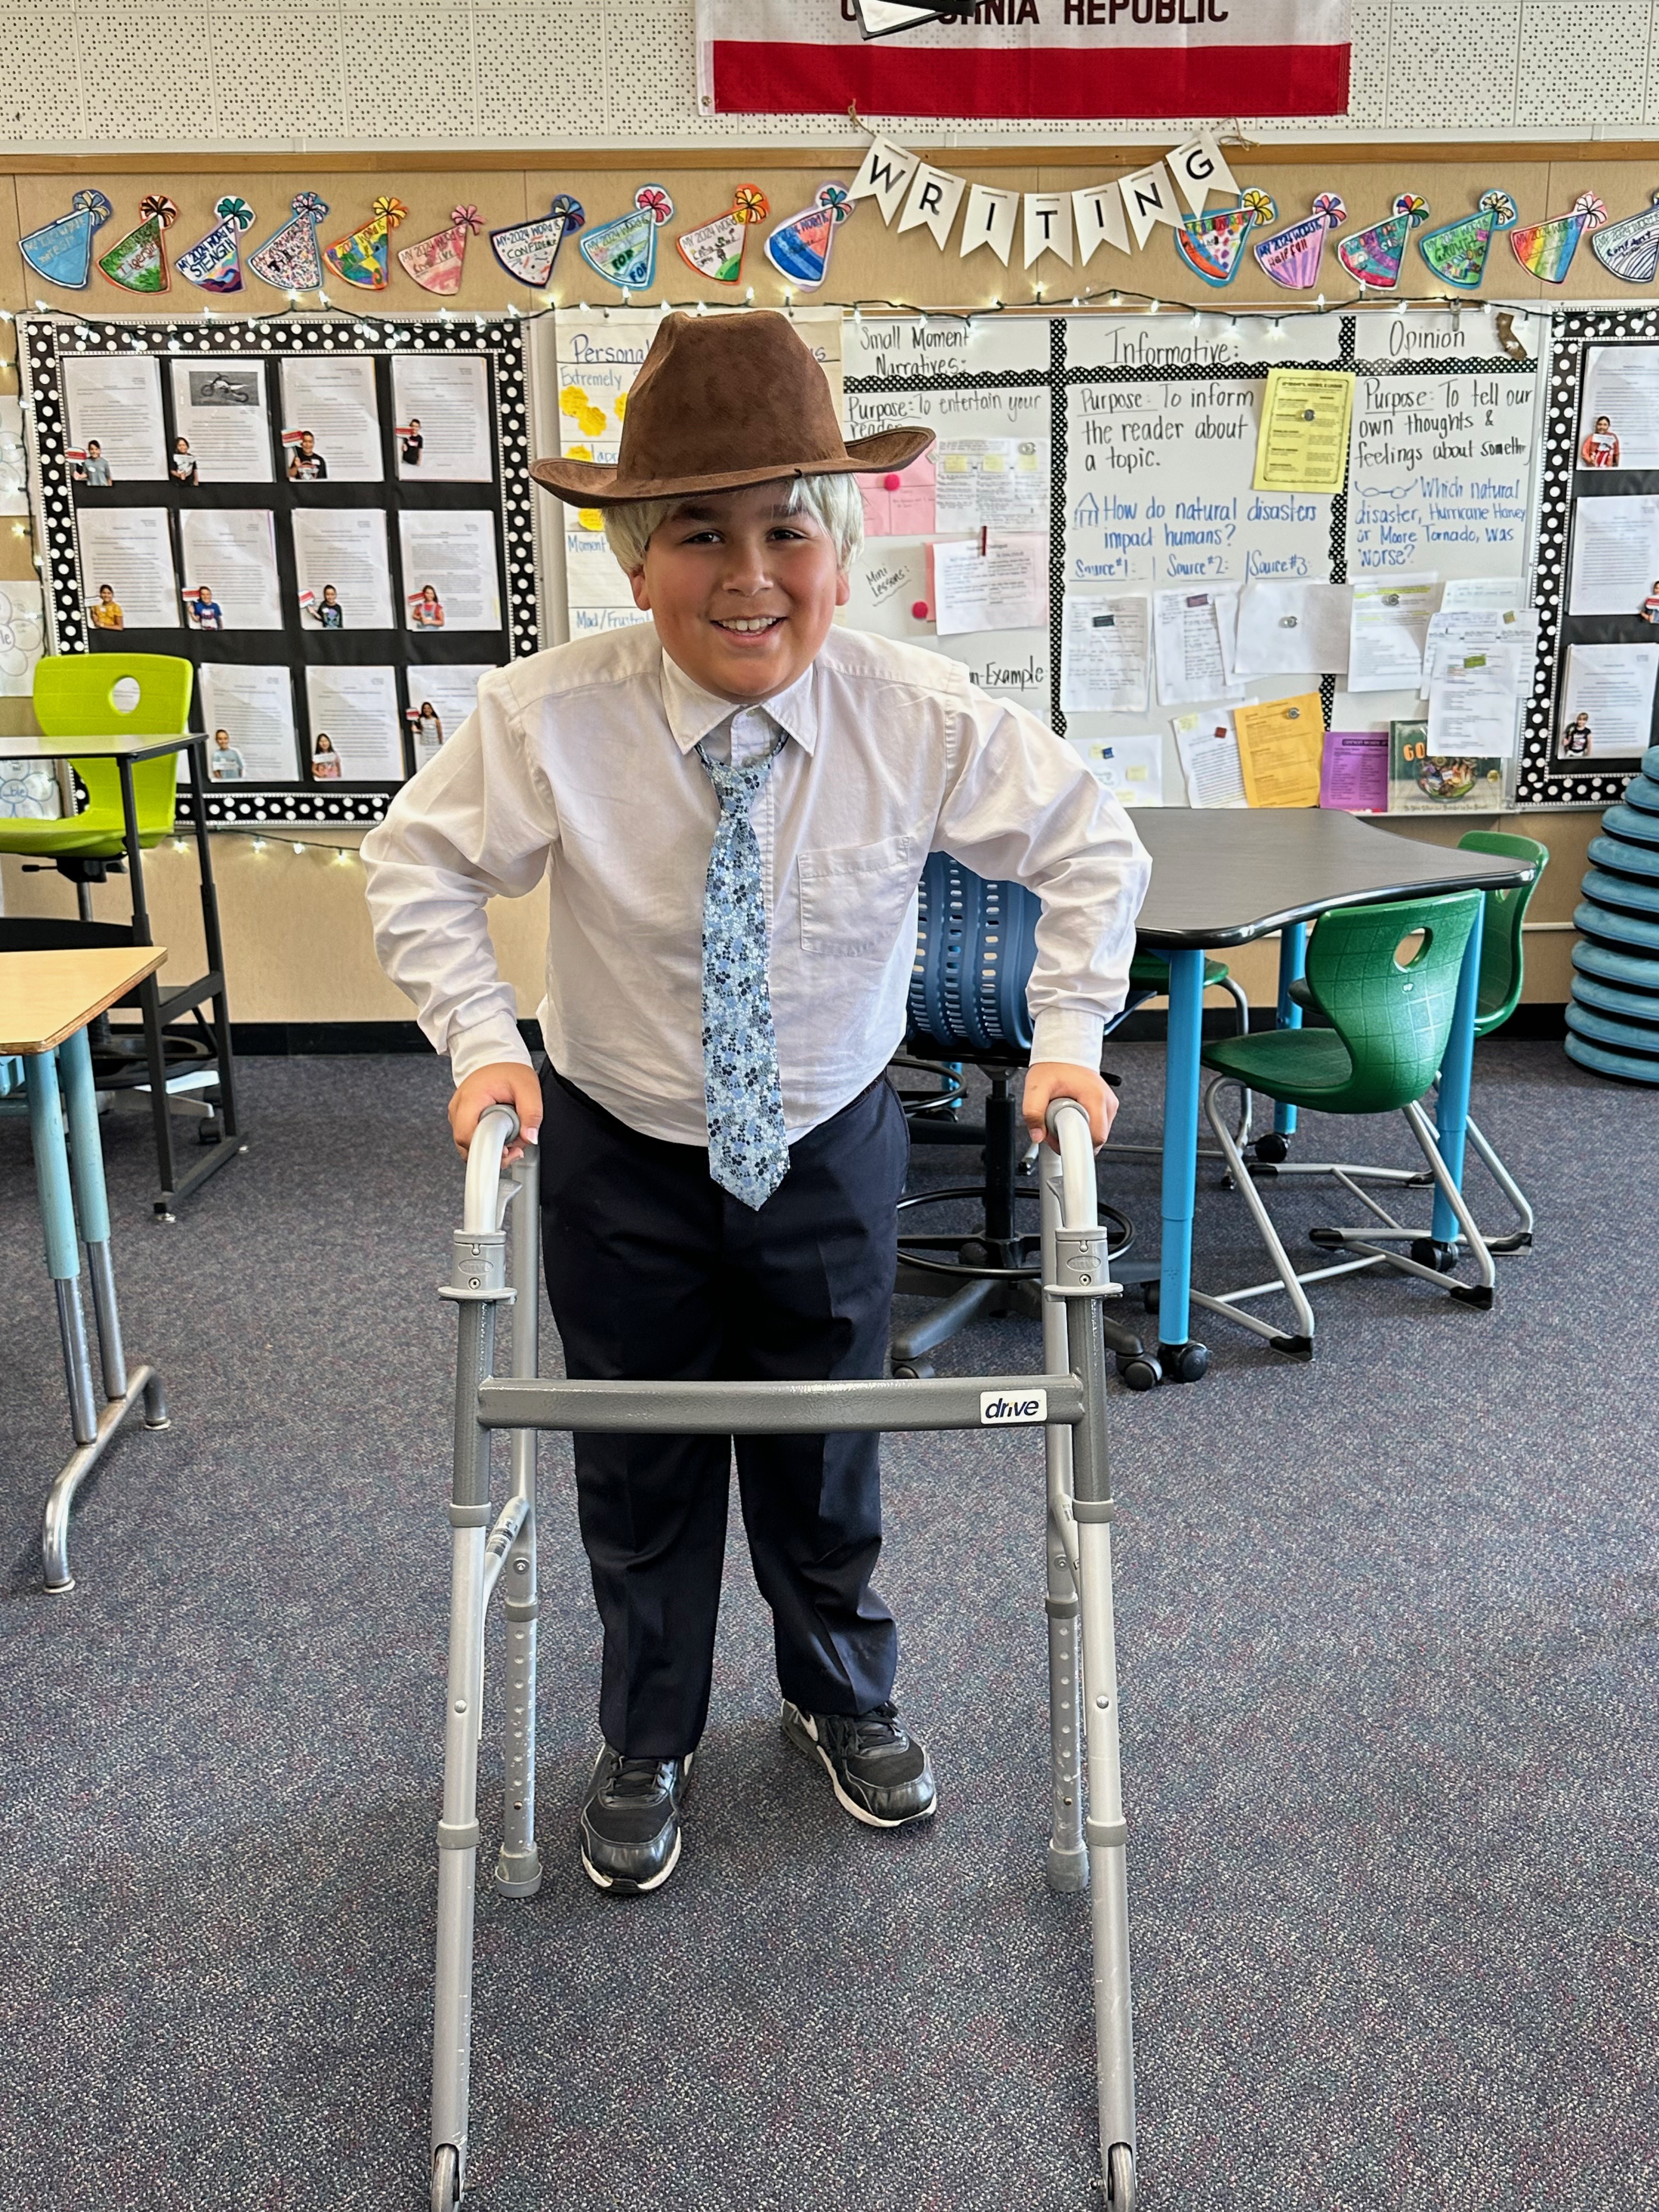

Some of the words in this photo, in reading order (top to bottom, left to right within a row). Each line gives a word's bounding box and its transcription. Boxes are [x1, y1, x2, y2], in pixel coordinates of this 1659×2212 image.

[1063, 0, 1229, 26] REPUBLIC
[869, 148, 1215, 240] WRITING
[860, 325, 900, 351] Small
[912, 326, 970, 350] Moment
[1105, 326, 1239, 365] Informative:
[1390, 320, 1465, 357] Opinion
[560, 365, 622, 390] Extremely
[913, 392, 932, 415] To
[939, 391, 1002, 414] entertain
[1008, 393, 1042, 422] your
[1080, 387, 1152, 414] Purpose:
[1159, 383, 1182, 408] To
[1190, 382, 1254, 408] inform
[1363, 377, 1435, 416] Purpose:
[1438, 378, 1460, 408] To
[1471, 379, 1498, 407] tell
[1506, 388, 1533, 407] our
[1081, 420, 1113, 445] the
[1121, 415, 1184, 442] reader
[1195, 415, 1249, 440] about
[1359, 419, 1393, 438] own
[1404, 411, 1474, 439] thoughts
[1485, 409, 1495, 426] &
[1085, 454, 1096, 471] a
[1105, 447, 1161, 473] topic.
[1353, 441, 1423, 472] feelings
[1433, 439, 1473, 460] about
[1420, 476, 1463, 499] Which
[1470, 477, 1520, 500] natural
[1104, 494, 1138, 521] How
[1146, 495, 1165, 521] do
[1176, 495, 1237, 521] natural
[1248, 494, 1317, 522] disasters
[1355, 500, 1422, 525] disaster,
[1429, 503, 1489, 521] Hurricane
[568, 534, 606, 554] Moment
[1104, 526, 1153, 555] impact
[1164, 523, 1237, 548] humans?
[1357, 528, 1371, 543] or
[1380, 525, 1418, 545] Moore
[1420, 523, 1480, 544] Tornado,
[1485, 527, 1514, 543] was
[1357, 544, 1415, 567] worse?
[865, 563, 889, 586] Mini
[985, 1398, 1040, 1419] drive
